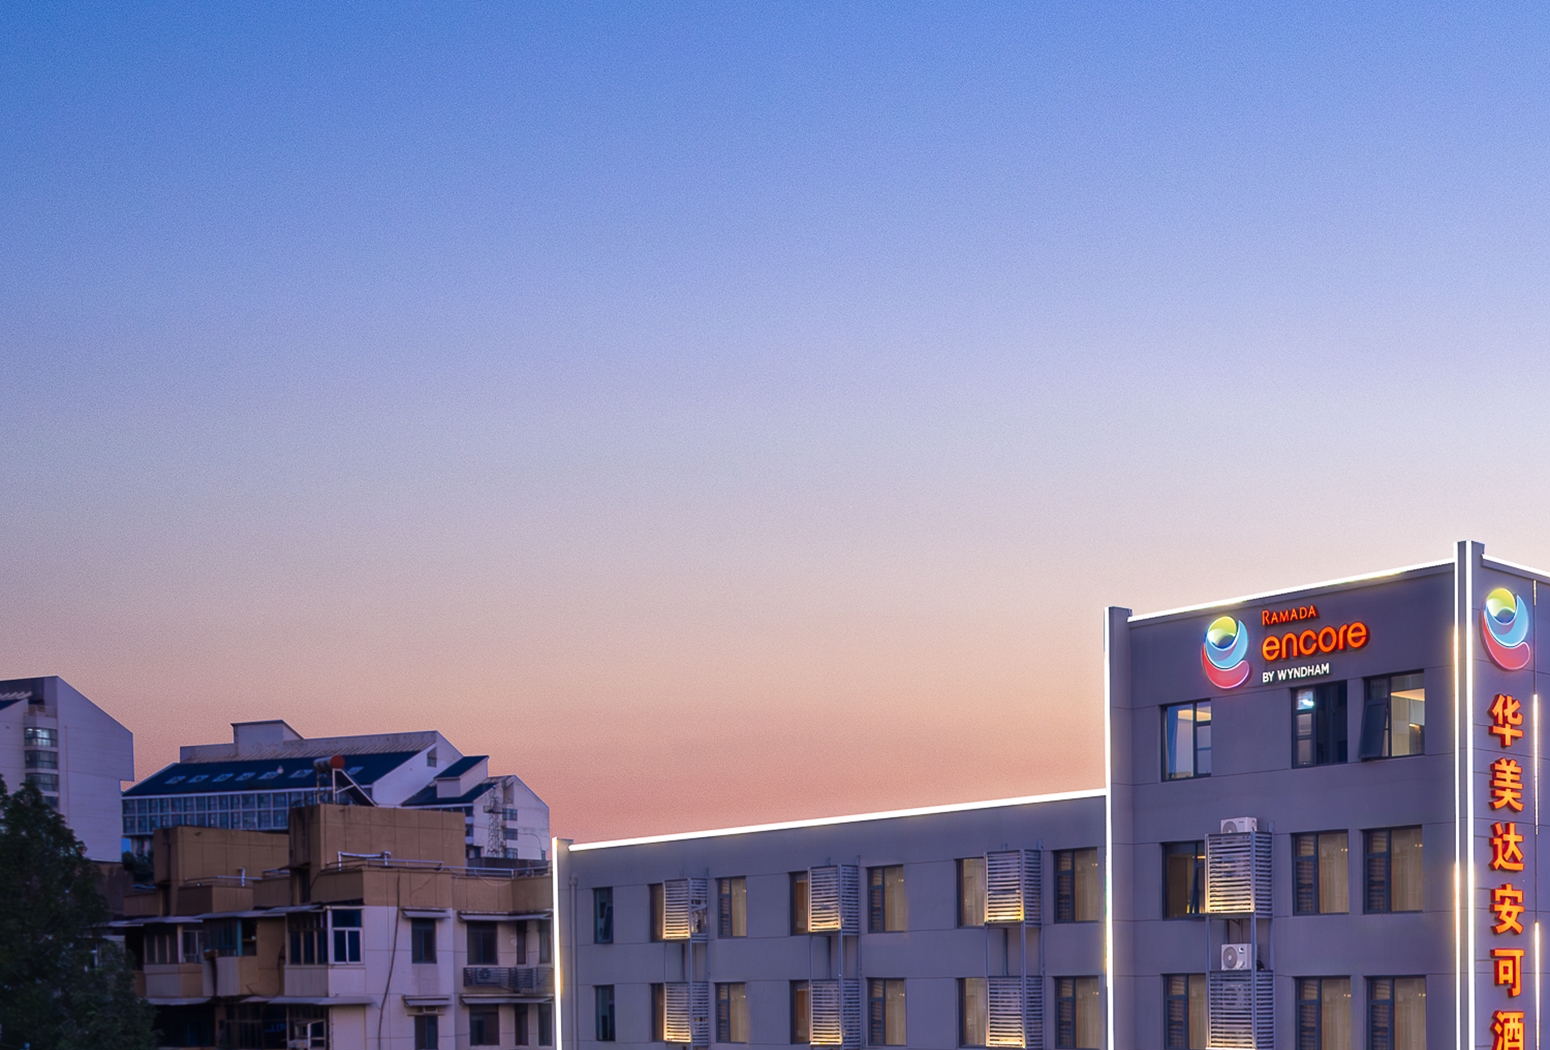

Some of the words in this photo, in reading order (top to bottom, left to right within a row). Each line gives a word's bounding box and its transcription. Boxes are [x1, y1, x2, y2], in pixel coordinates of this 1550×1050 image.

[1262, 605, 1317, 626] RAMADA
[1262, 621, 1368, 661] encore
[1262, 670, 1275, 683] BY
[1277, 662, 1330, 681] WYNDHAM
